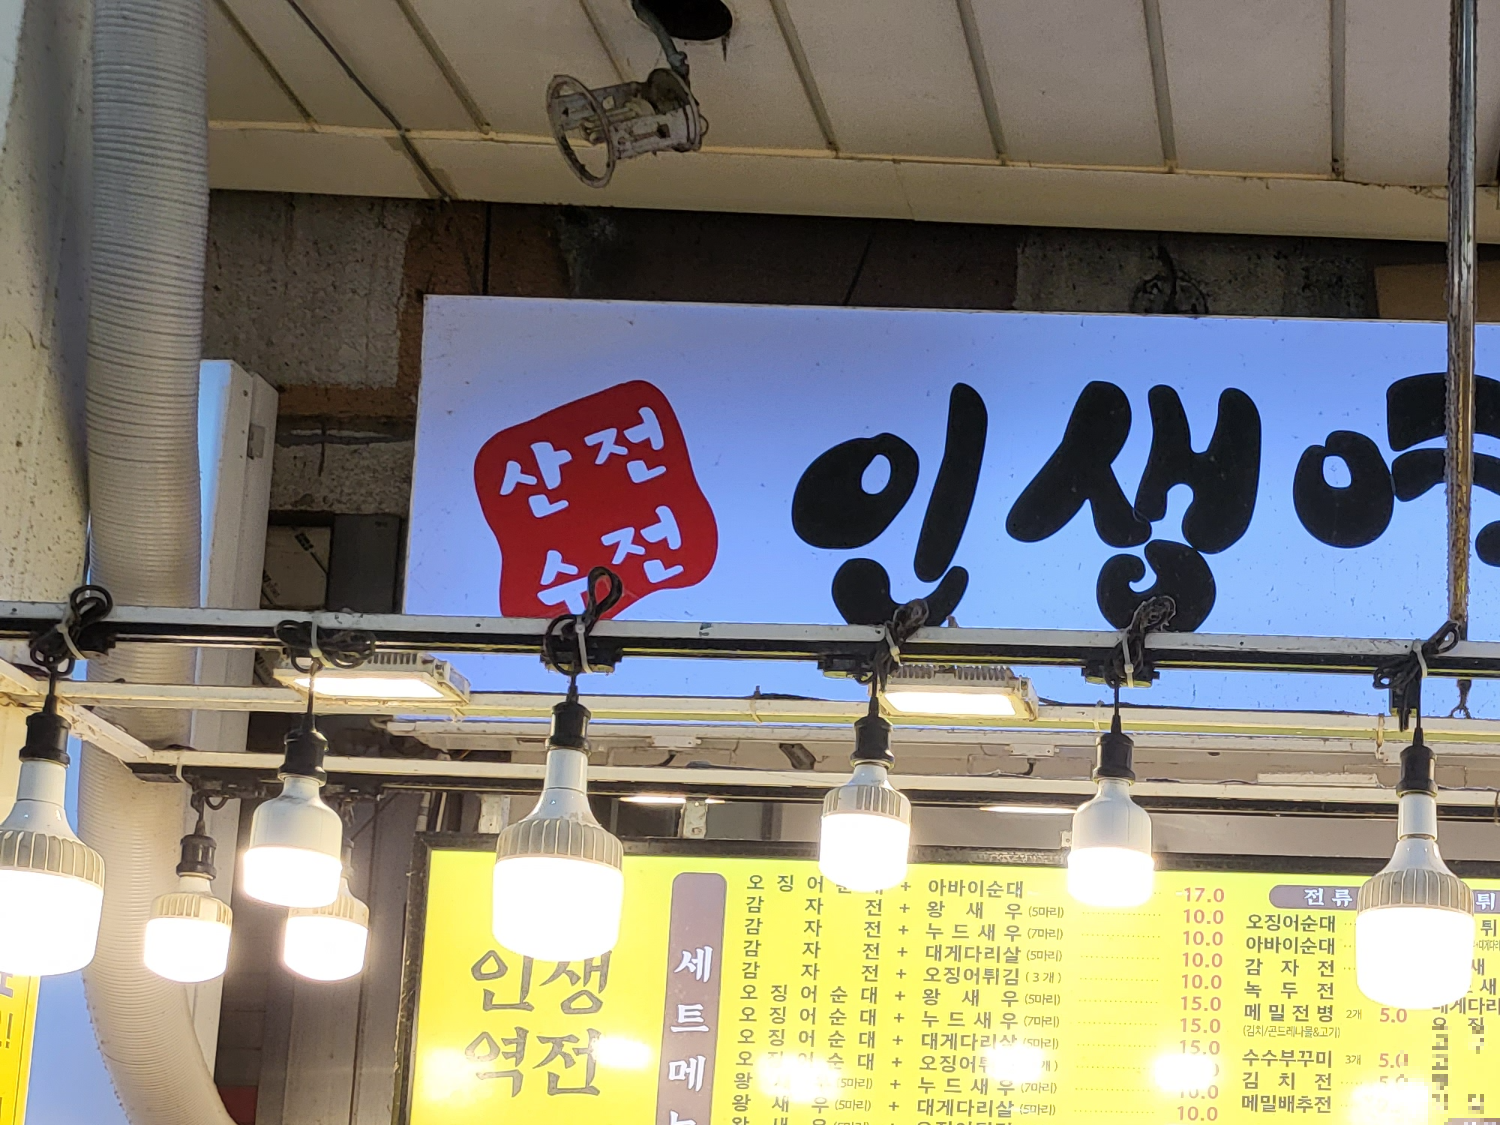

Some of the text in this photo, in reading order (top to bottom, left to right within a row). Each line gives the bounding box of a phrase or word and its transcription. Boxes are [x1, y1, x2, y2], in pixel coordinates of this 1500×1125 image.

[500, 406, 667, 520] 산전
[929, 879, 1023, 898] 아바이순대
[1184, 887, 1224, 902] 17.0
[1304, 888, 1353, 907] 전류
[1184, 909, 1224, 924] 10.0
[1246, 914, 1335, 933] 오징어순대
[926, 923, 1021, 942] 누드새우
[1183, 931, 1223, 946] 10.0
[1246, 936, 1334, 955] 아바이순대
[926, 944, 1021, 964] 대게다리살
[1183, 952, 1222, 968] 10.0
[471, 950, 612, 1014] 인생
[923, 967, 1019, 986] 오징어튀김
[1182, 974, 1222, 989] 10.0
[740, 985, 877, 1004] 오징어순대
[1181, 996, 1221, 1011] 15.0
[739, 1006, 876, 1026] 오징어순대
[922, 1011, 1018, 1030] 누드새우
[1181, 1018, 1220, 1033] 15.0
[1245, 1003, 1407, 1023] 메밀전병 2개 5.0
[738, 1029, 875, 1049] 오징어순대
[1179, 1039, 1220, 1055] 15.0
[463, 1026, 602, 1098] 역전
[1242, 1049, 1331, 1068] 수수부꾸미
[1345, 1055, 1361, 1065] 3개
[918, 1077, 1015, 1096] 누드새우
[1021, 1083, 1057, 1094] (7마리)
[917, 1099, 1014, 1118] 대게다리살
[1177, 1106, 1218, 1121] 10.0
[1242, 1094, 1331, 1113] 메밀배추전
